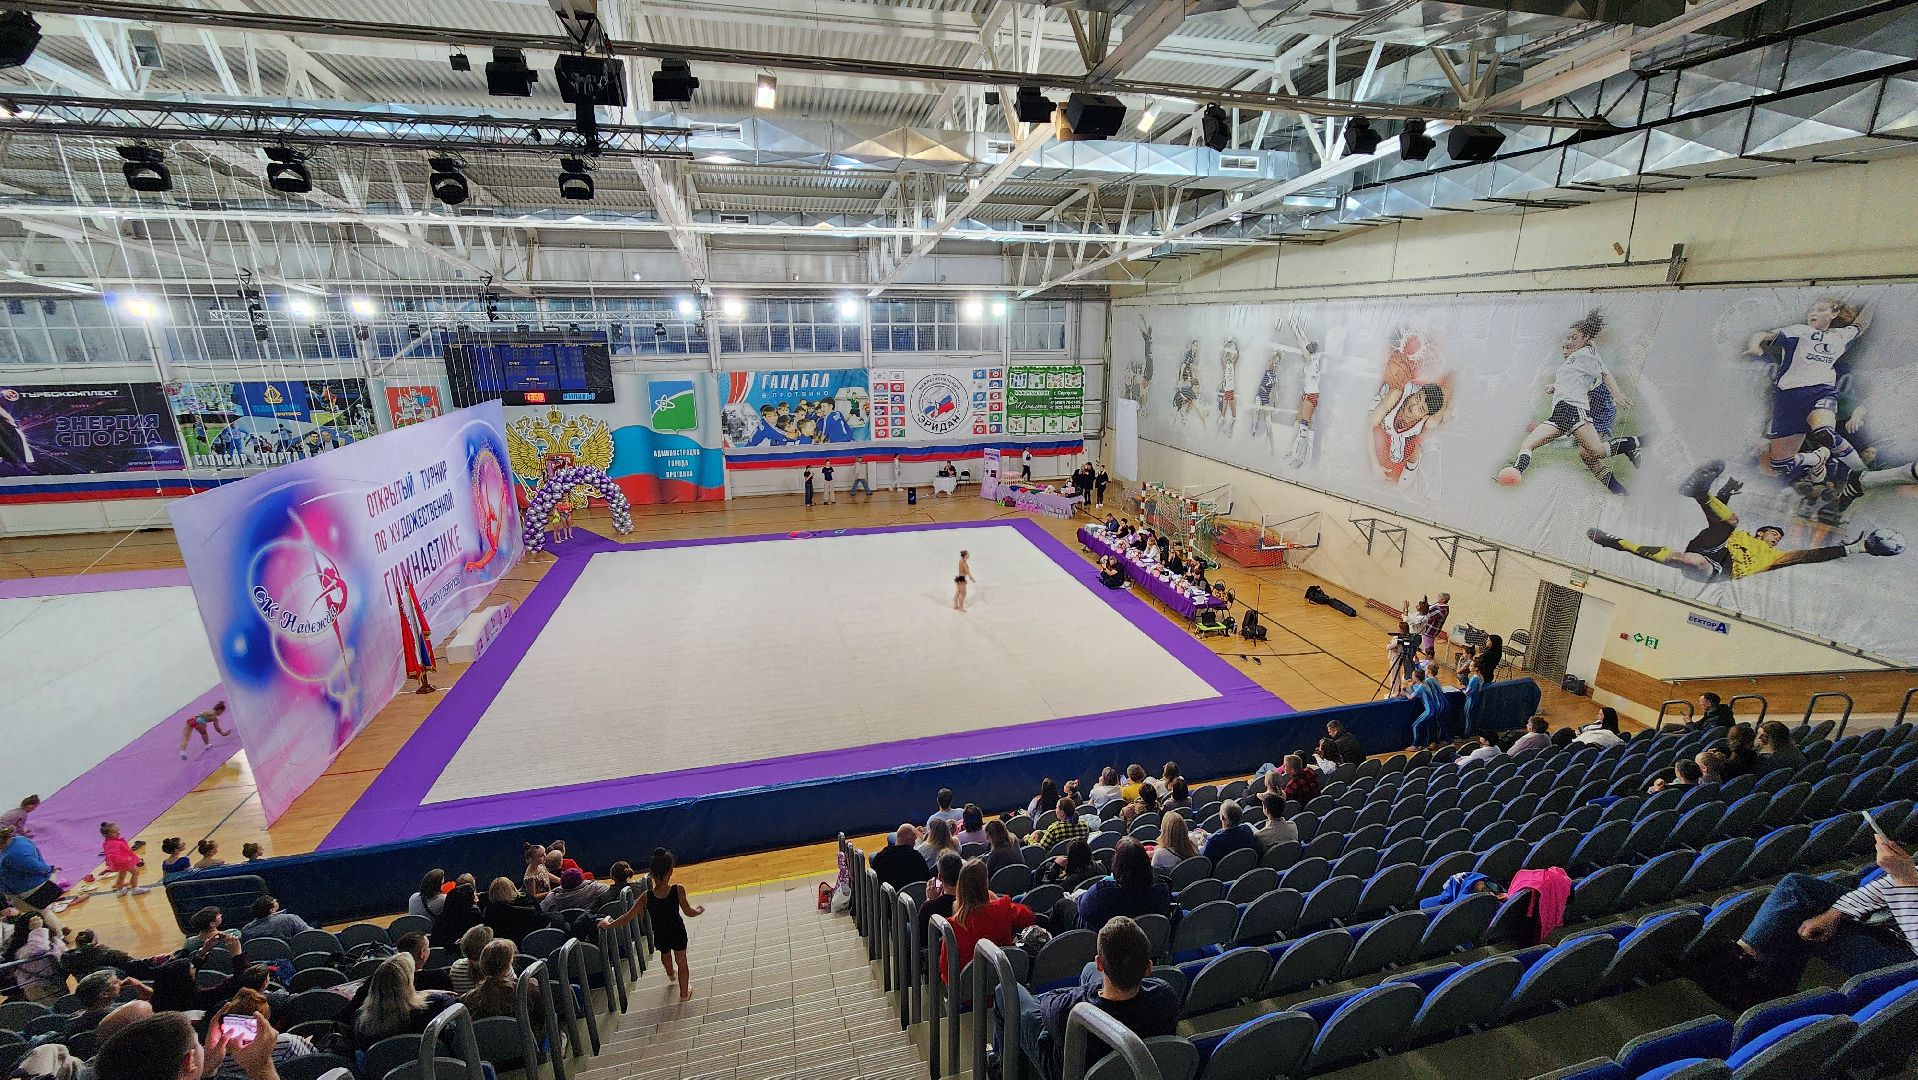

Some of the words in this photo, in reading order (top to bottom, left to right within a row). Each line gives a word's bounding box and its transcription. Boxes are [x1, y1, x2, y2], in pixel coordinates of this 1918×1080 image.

[762, 373, 830, 391] ГАНДБОЛ
[19, 389, 119, 398] ТУРБОКОМПЛЕКТ
[772, 390, 829, 398] ПРОТВИНО
[56, 413, 160, 432] ЭНЕРГИЯ
[917, 414, 961, 432] ЭРИДАН
[55, 429, 162, 447] СПОРТА
[194, 453, 249, 466] СПОНСОР
[254, 451, 300, 466] СПОРТА
[653, 448, 700, 458] АДМИНИСТРАЦИЯ
[667, 459, 689, 468] ГОРОДА
[366, 471, 416, 518] ОТКРЫТЫЙ
[420, 460, 448, 491] ТУРНИР
[374, 529, 388, 554] ПО
[388, 489, 455, 545] ХУДОЖЕСТВЕННОЙ
[383, 524, 463, 606] ГИМНАСТИКЕ
[1688, 615, 1717, 628] СЕКТОР
[1715, 622, 1727, 634] А
